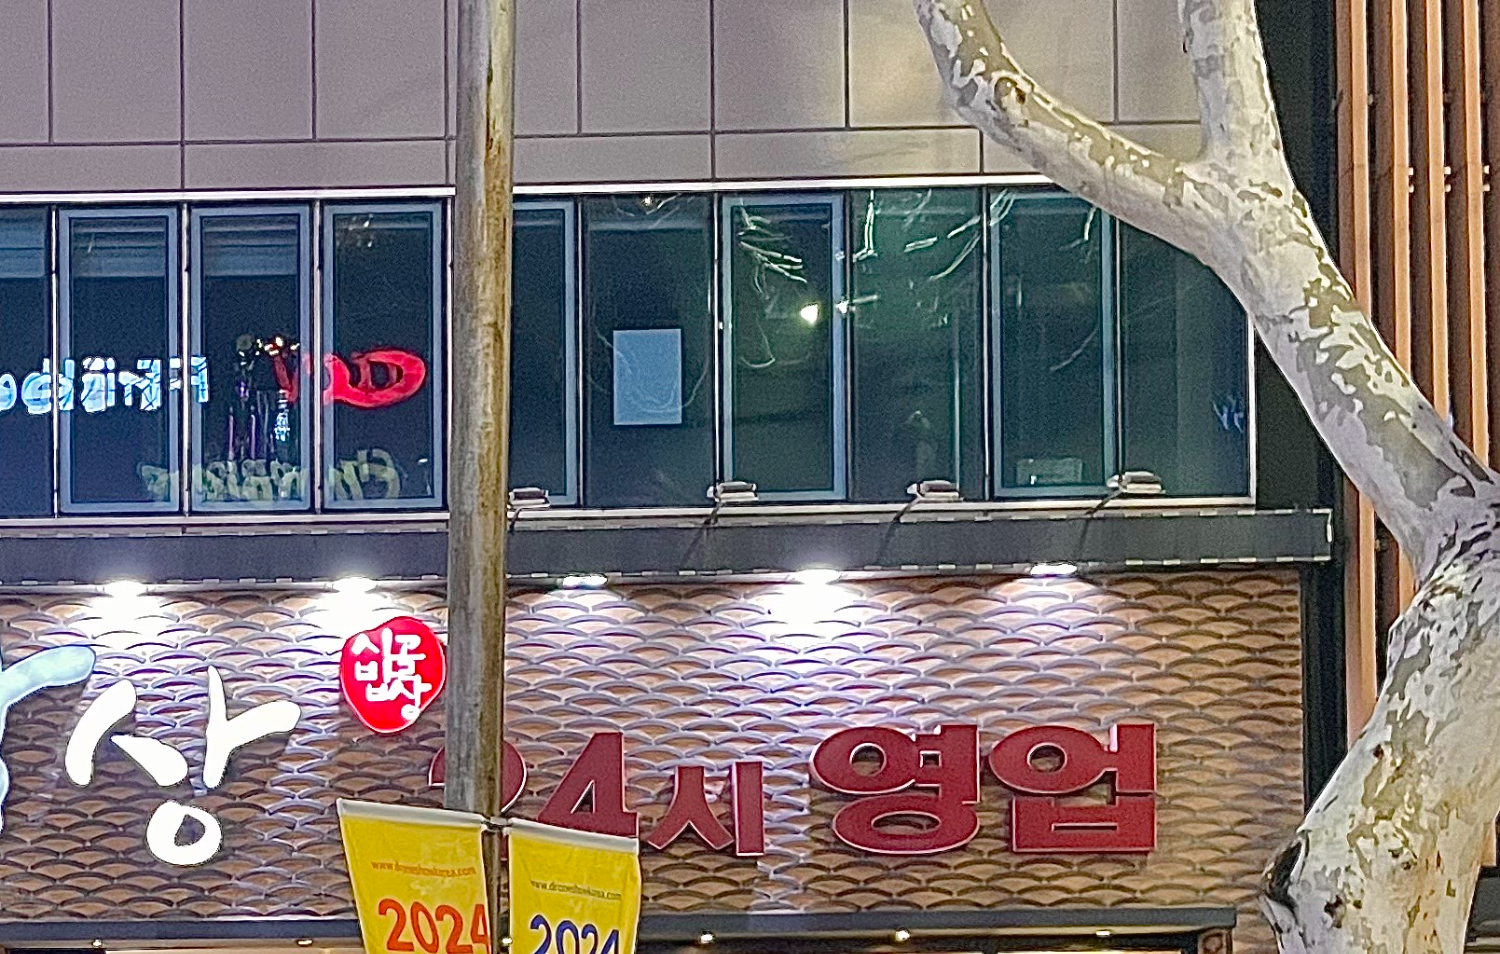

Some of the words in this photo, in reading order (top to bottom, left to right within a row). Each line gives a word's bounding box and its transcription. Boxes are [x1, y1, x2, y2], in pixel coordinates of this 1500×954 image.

[428, 731, 765, 857] 4시
[809, 723, 1157, 854] 영업
[378, 898, 490, 954] 2024
